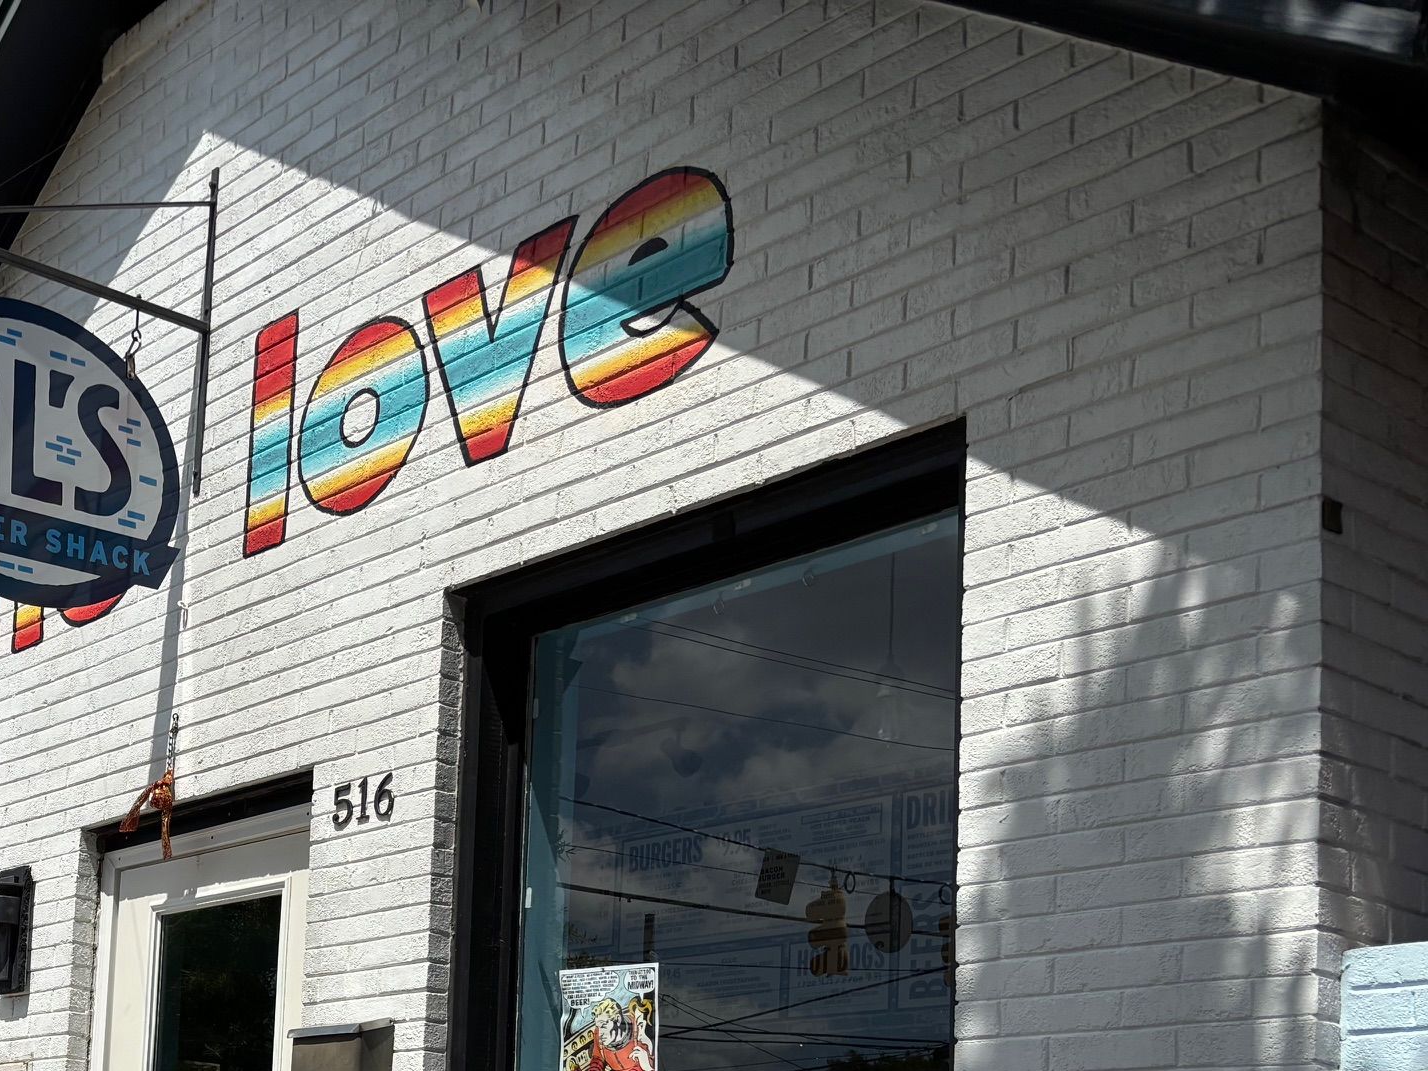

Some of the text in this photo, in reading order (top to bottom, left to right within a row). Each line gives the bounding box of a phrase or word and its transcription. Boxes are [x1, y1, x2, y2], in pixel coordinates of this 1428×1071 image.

[242, 165, 735, 558] love
[44, 528, 151, 576] SHACK
[332, 772, 394, 827] 516
[907, 789, 954, 830] DRI
[628, 980, 654, 990] MIDWAY!
